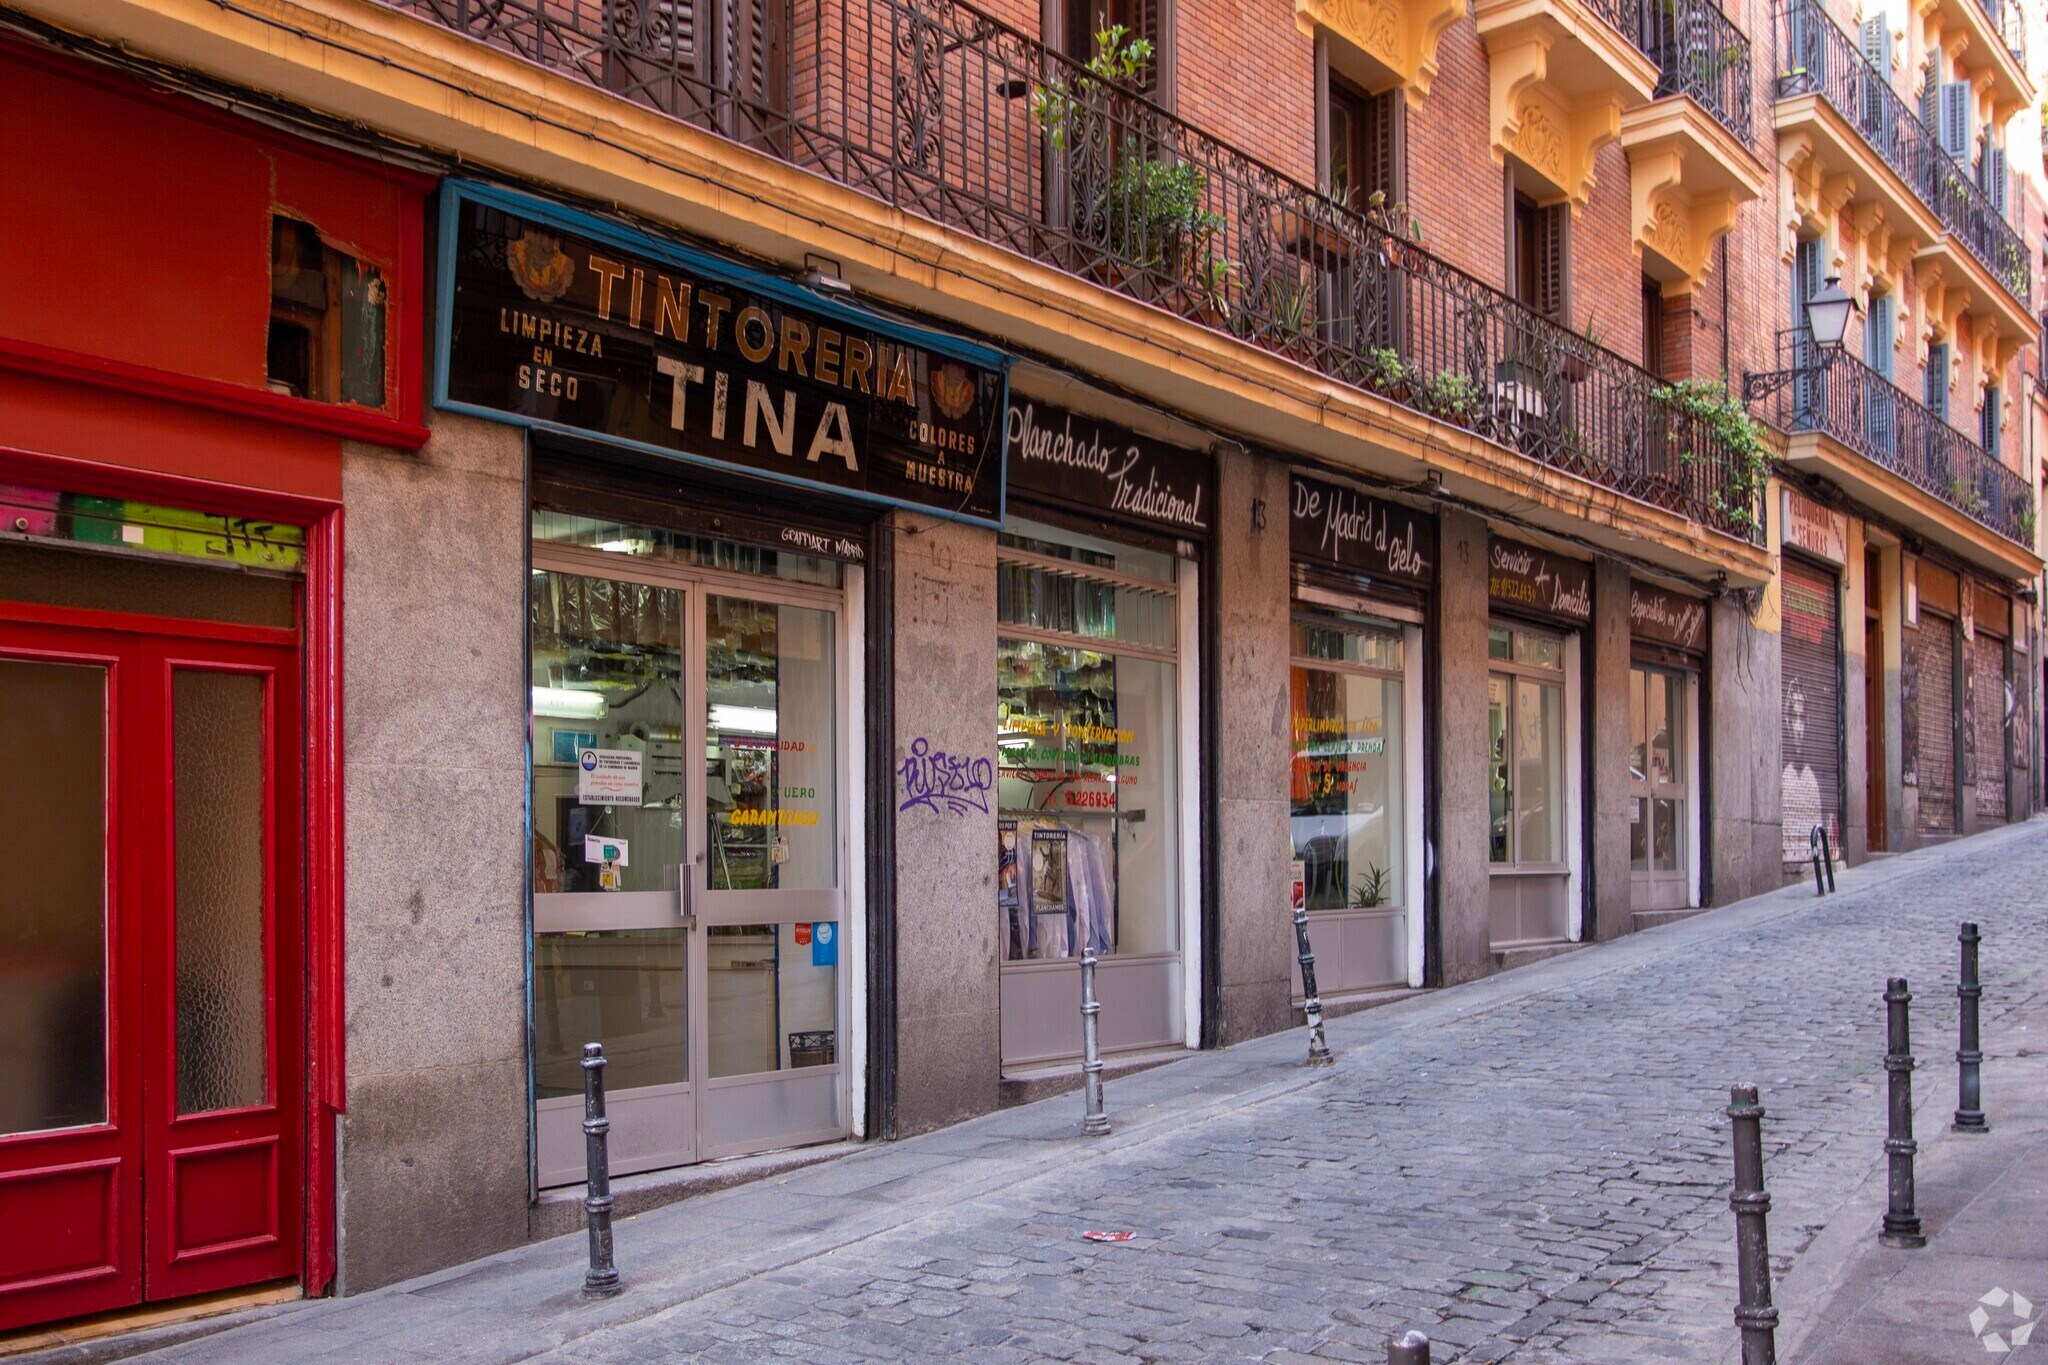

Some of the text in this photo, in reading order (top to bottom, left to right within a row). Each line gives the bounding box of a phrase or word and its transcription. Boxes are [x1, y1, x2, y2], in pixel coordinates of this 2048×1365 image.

[500, 307, 602, 358] LIMPIEZA
[588, 254, 916, 407] TINTORERIA
[533, 345, 553, 367] EN
[518, 364, 578, 401] SECO
[656, 354, 859, 472] TINA
[909, 420, 975, 455] COLORES
[1007, 403, 1117, 474] Planchado
[937, 450, 946, 466] A
[905, 460, 973, 494] MUESTRA
[1107, 446, 1206, 528] Tradicional
[1293, 480, 1431, 576] De Madrid al Cielo
[1797, 523, 1828, 558] SEÑORAS
[1490, 545, 1533, 576] Servicio
[1549, 572, 1590, 617] Domicilio
[777, 786, 816, 799] UERO
[730, 808, 819, 827] GARANTIZADO
[1033, 831, 1067, 840] TINTORERÍA
